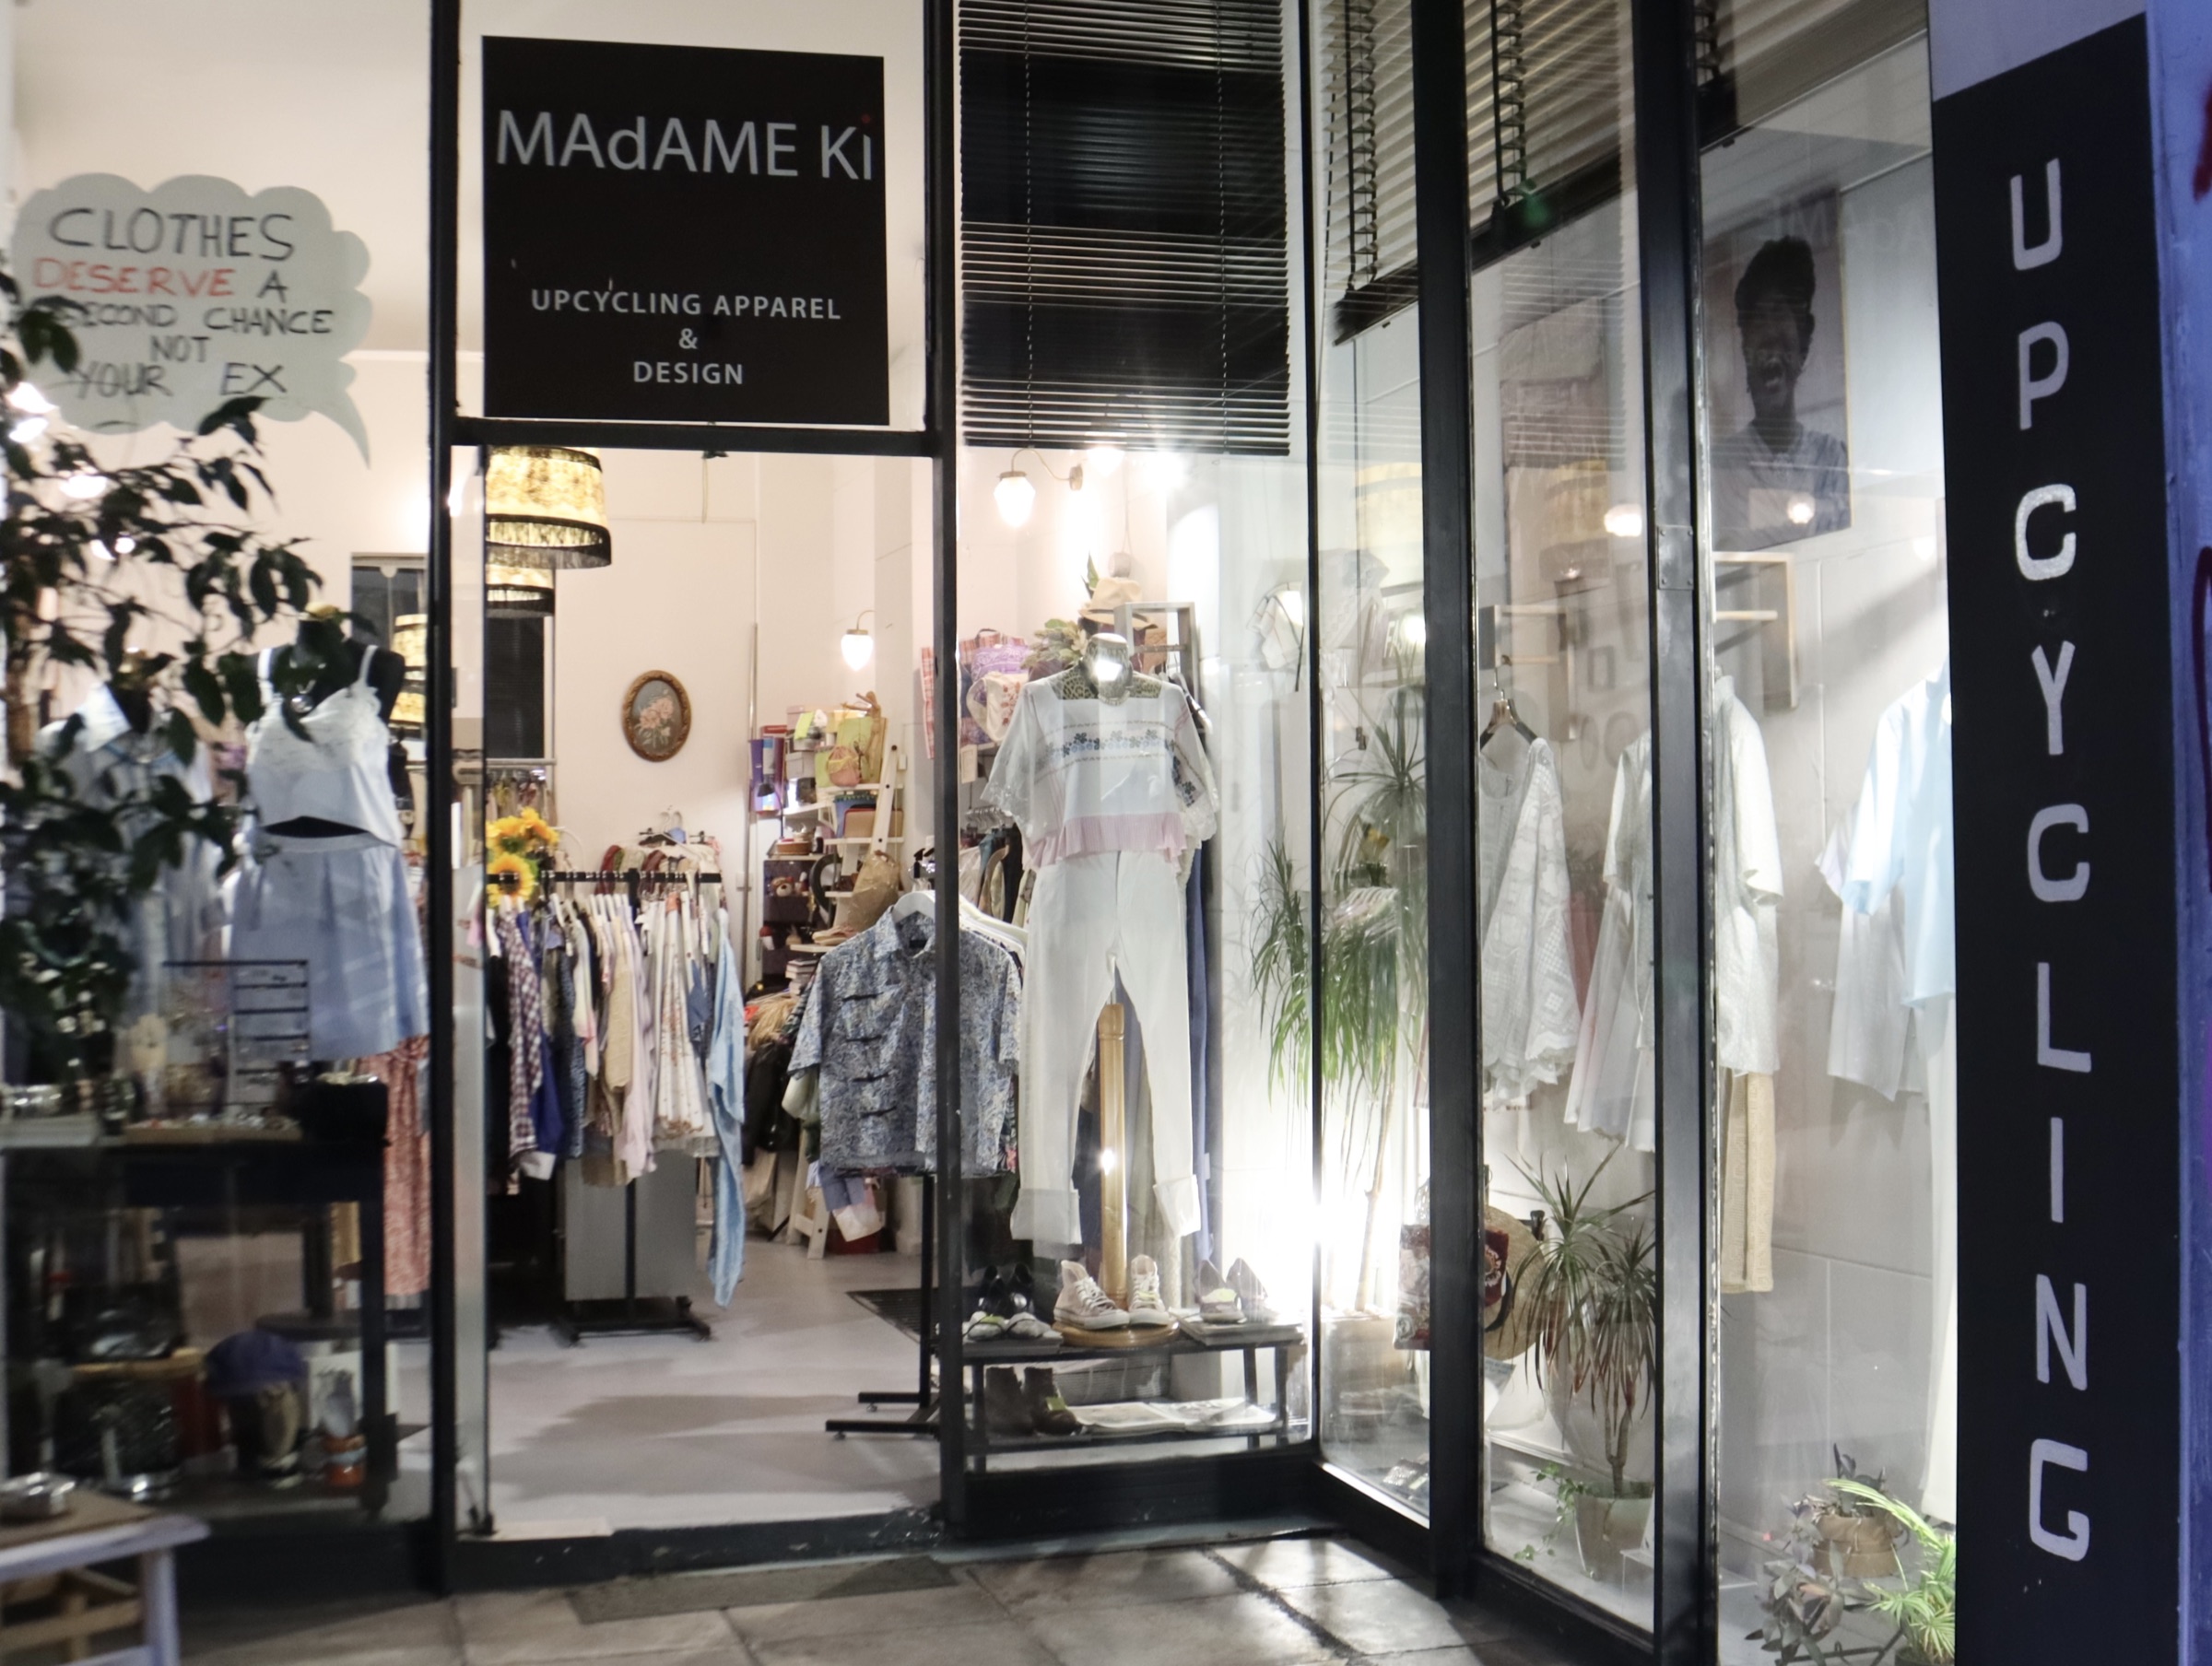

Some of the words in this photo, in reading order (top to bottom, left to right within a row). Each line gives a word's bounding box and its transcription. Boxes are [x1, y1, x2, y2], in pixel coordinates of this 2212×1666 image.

[496, 109, 799, 178] MAdAME
[820, 113, 872, 181] Ki
[49, 207, 295, 262] CLOTHES
[33, 257, 237, 298] DESERVE
[257, 270, 289, 303] A
[204, 307, 334, 335] CHANCE
[531, 288, 701, 316] UPCYCLING
[712, 295, 841, 321] APPAREL
[150, 335, 210, 363] NOT
[678, 328, 699, 350] &
[75, 360, 173, 399] YOUR
[219, 362, 288, 396] EX
[633, 361, 744, 385] DESIGN
[2009, 158, 2091, 1563] UPCYCLING
